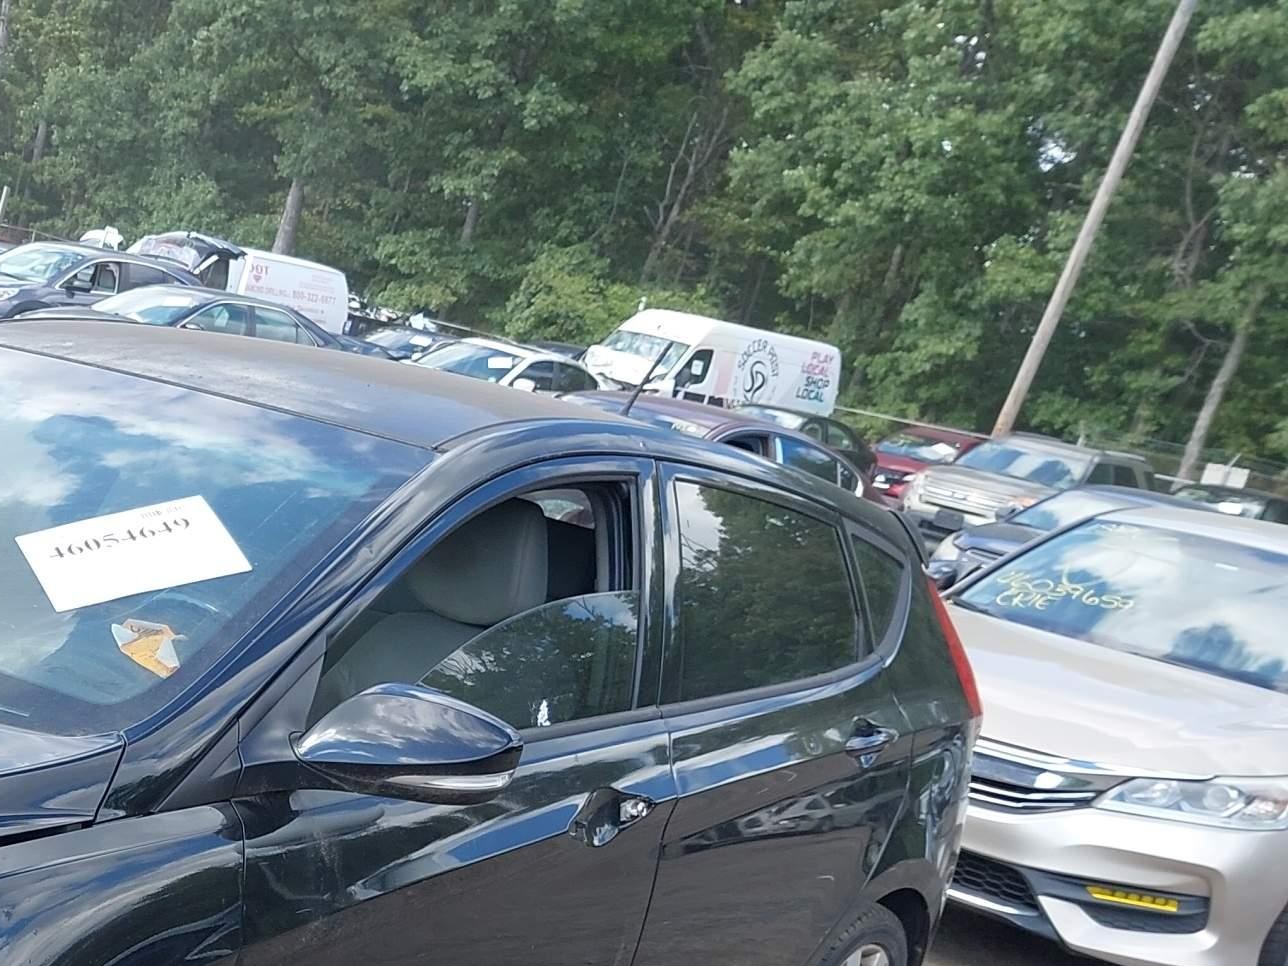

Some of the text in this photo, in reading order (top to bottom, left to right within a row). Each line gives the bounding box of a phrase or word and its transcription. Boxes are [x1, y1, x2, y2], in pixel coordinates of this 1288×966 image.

[738, 339, 768, 371] SOCCER
[811, 352, 834, 364] PLAY
[801, 362, 829, 378] LOCAL
[805, 376, 830, 390] SHOP
[796, 387, 824, 403] LOCAL
[49, 517, 191, 559] 46054649
